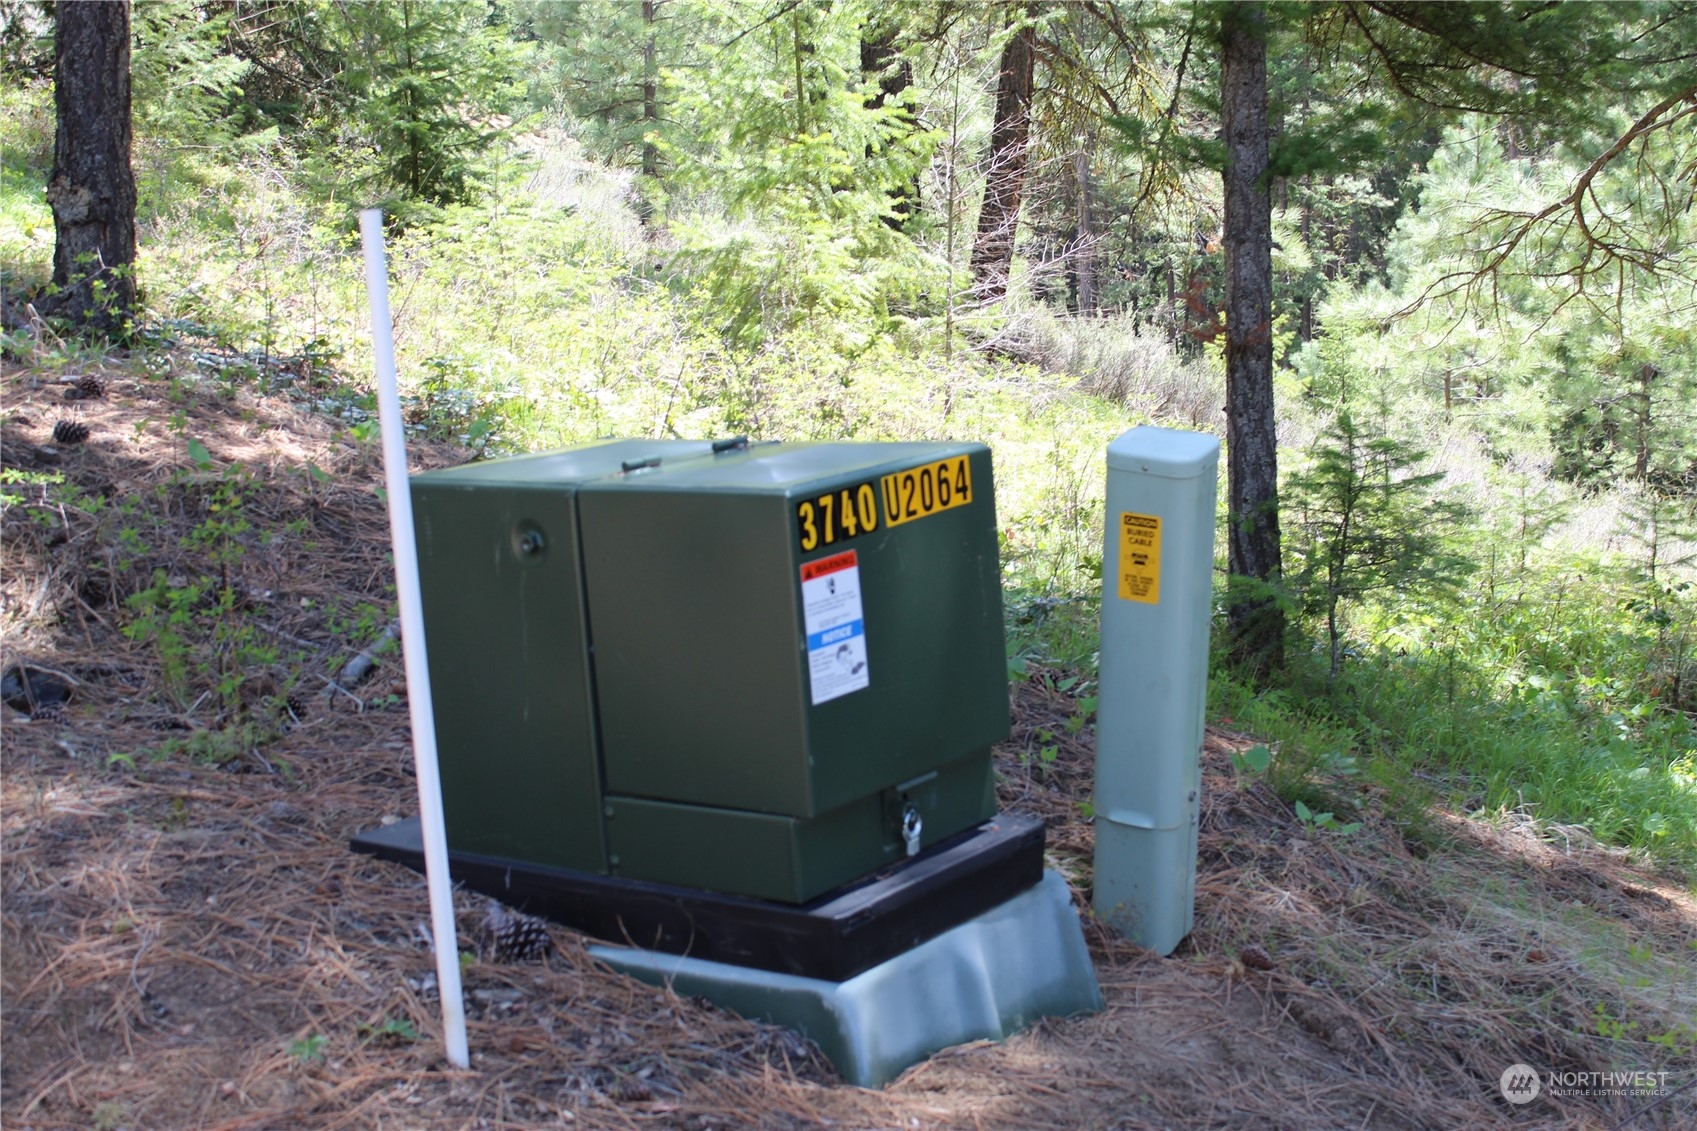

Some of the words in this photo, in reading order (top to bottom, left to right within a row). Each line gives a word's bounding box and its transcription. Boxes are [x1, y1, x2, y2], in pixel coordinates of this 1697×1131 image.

[798, 483, 878, 551] 3740
[884, 459, 969, 522] U2064
[1127, 528, 1155, 538] BURIED
[1128, 537, 1152, 547] CABLE
[821, 624, 852, 645] NOTICE
